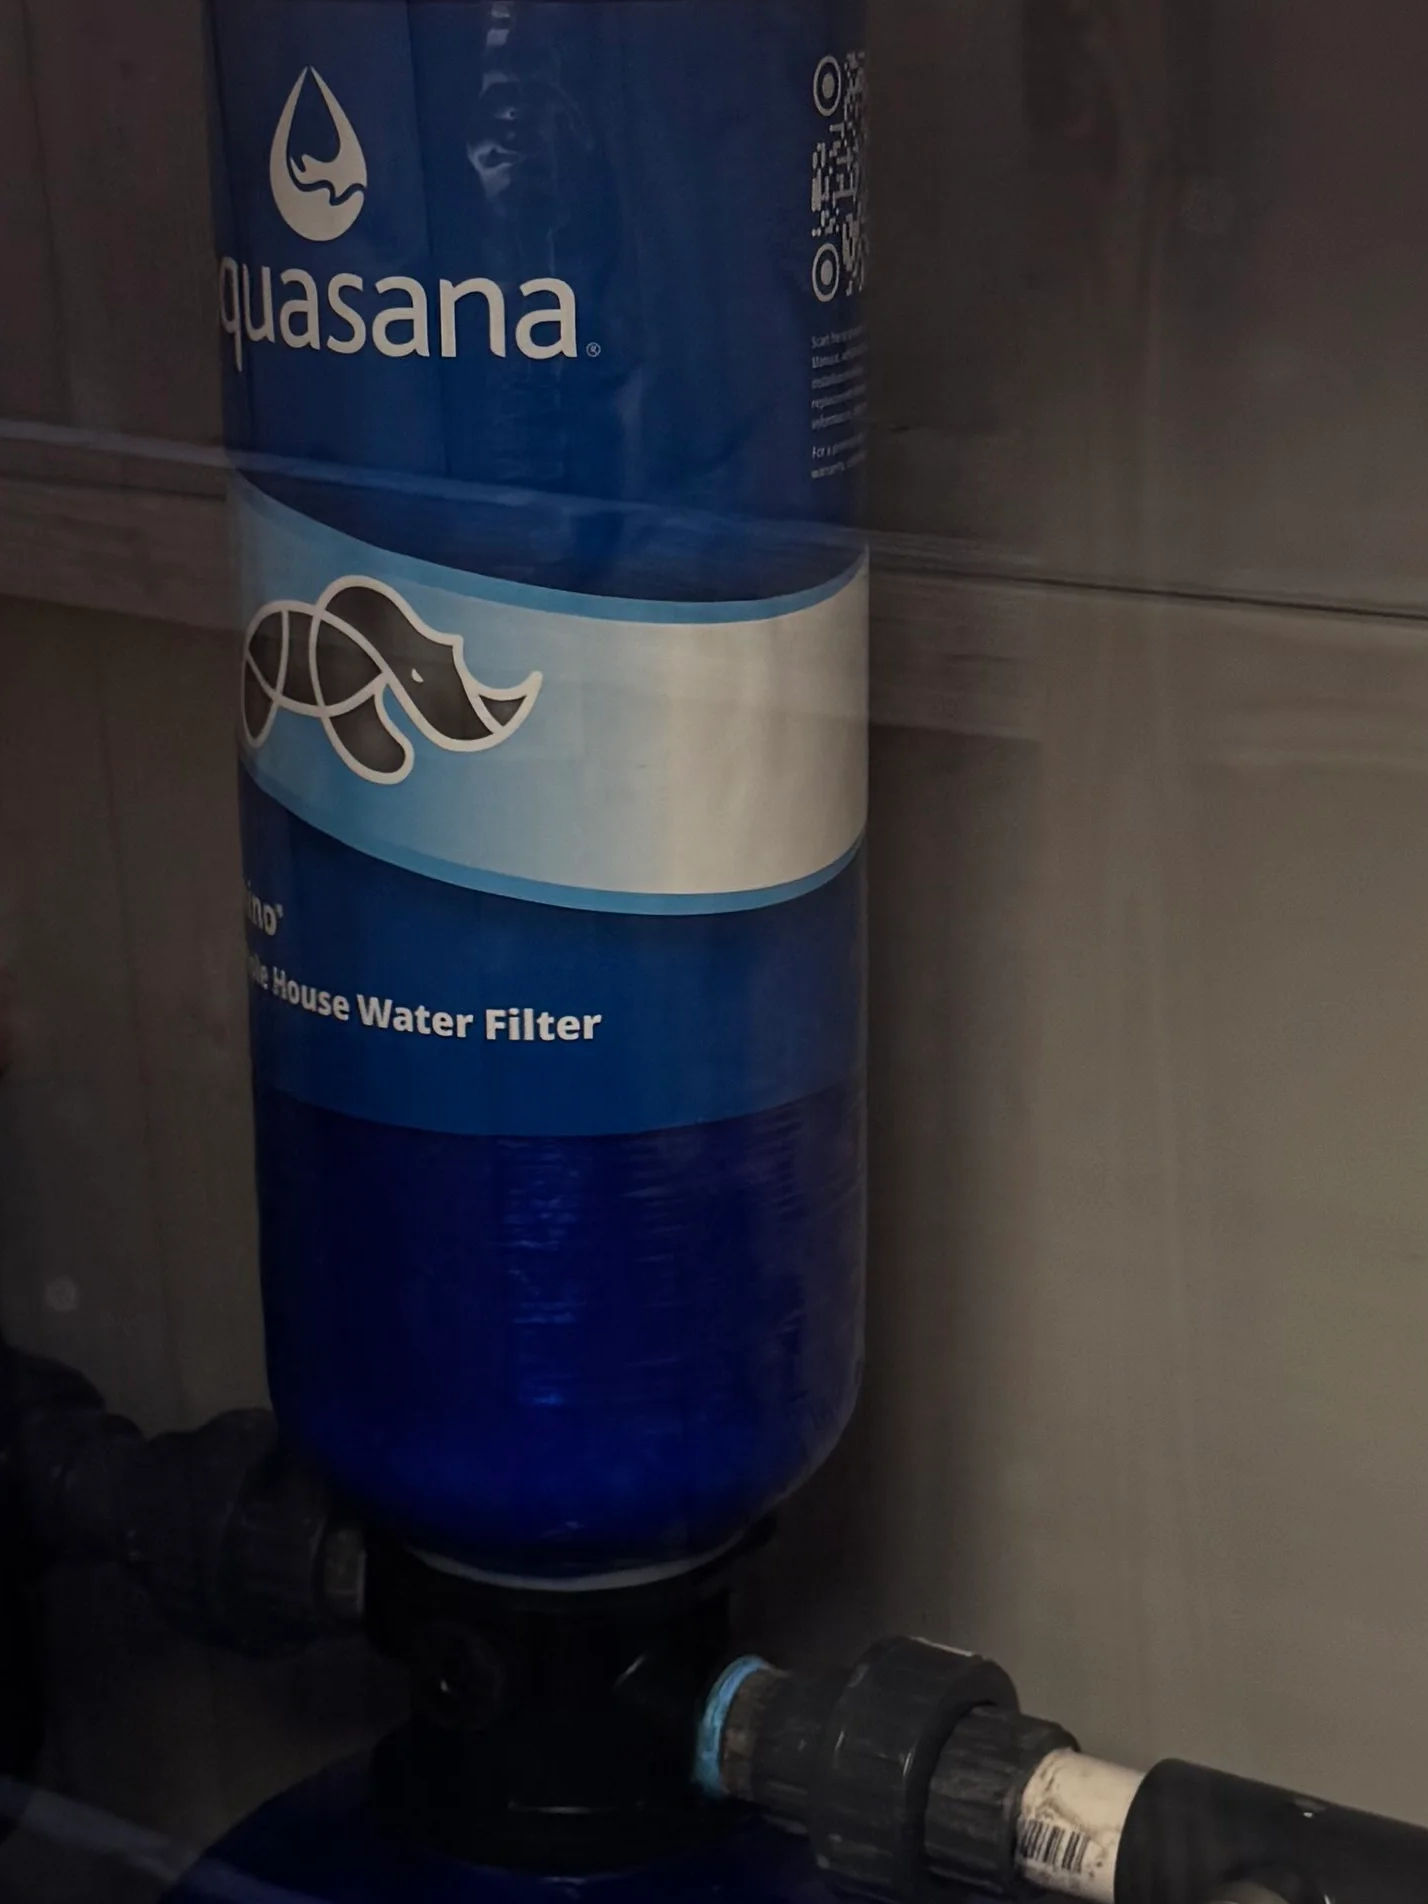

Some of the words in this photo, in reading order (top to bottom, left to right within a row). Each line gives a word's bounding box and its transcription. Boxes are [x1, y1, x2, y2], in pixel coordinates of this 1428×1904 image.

[219, 255, 578, 373] quasana
[271, 966, 350, 1021] House
[356, 994, 474, 1038] Water
[485, 1007, 602, 1042] Filter
